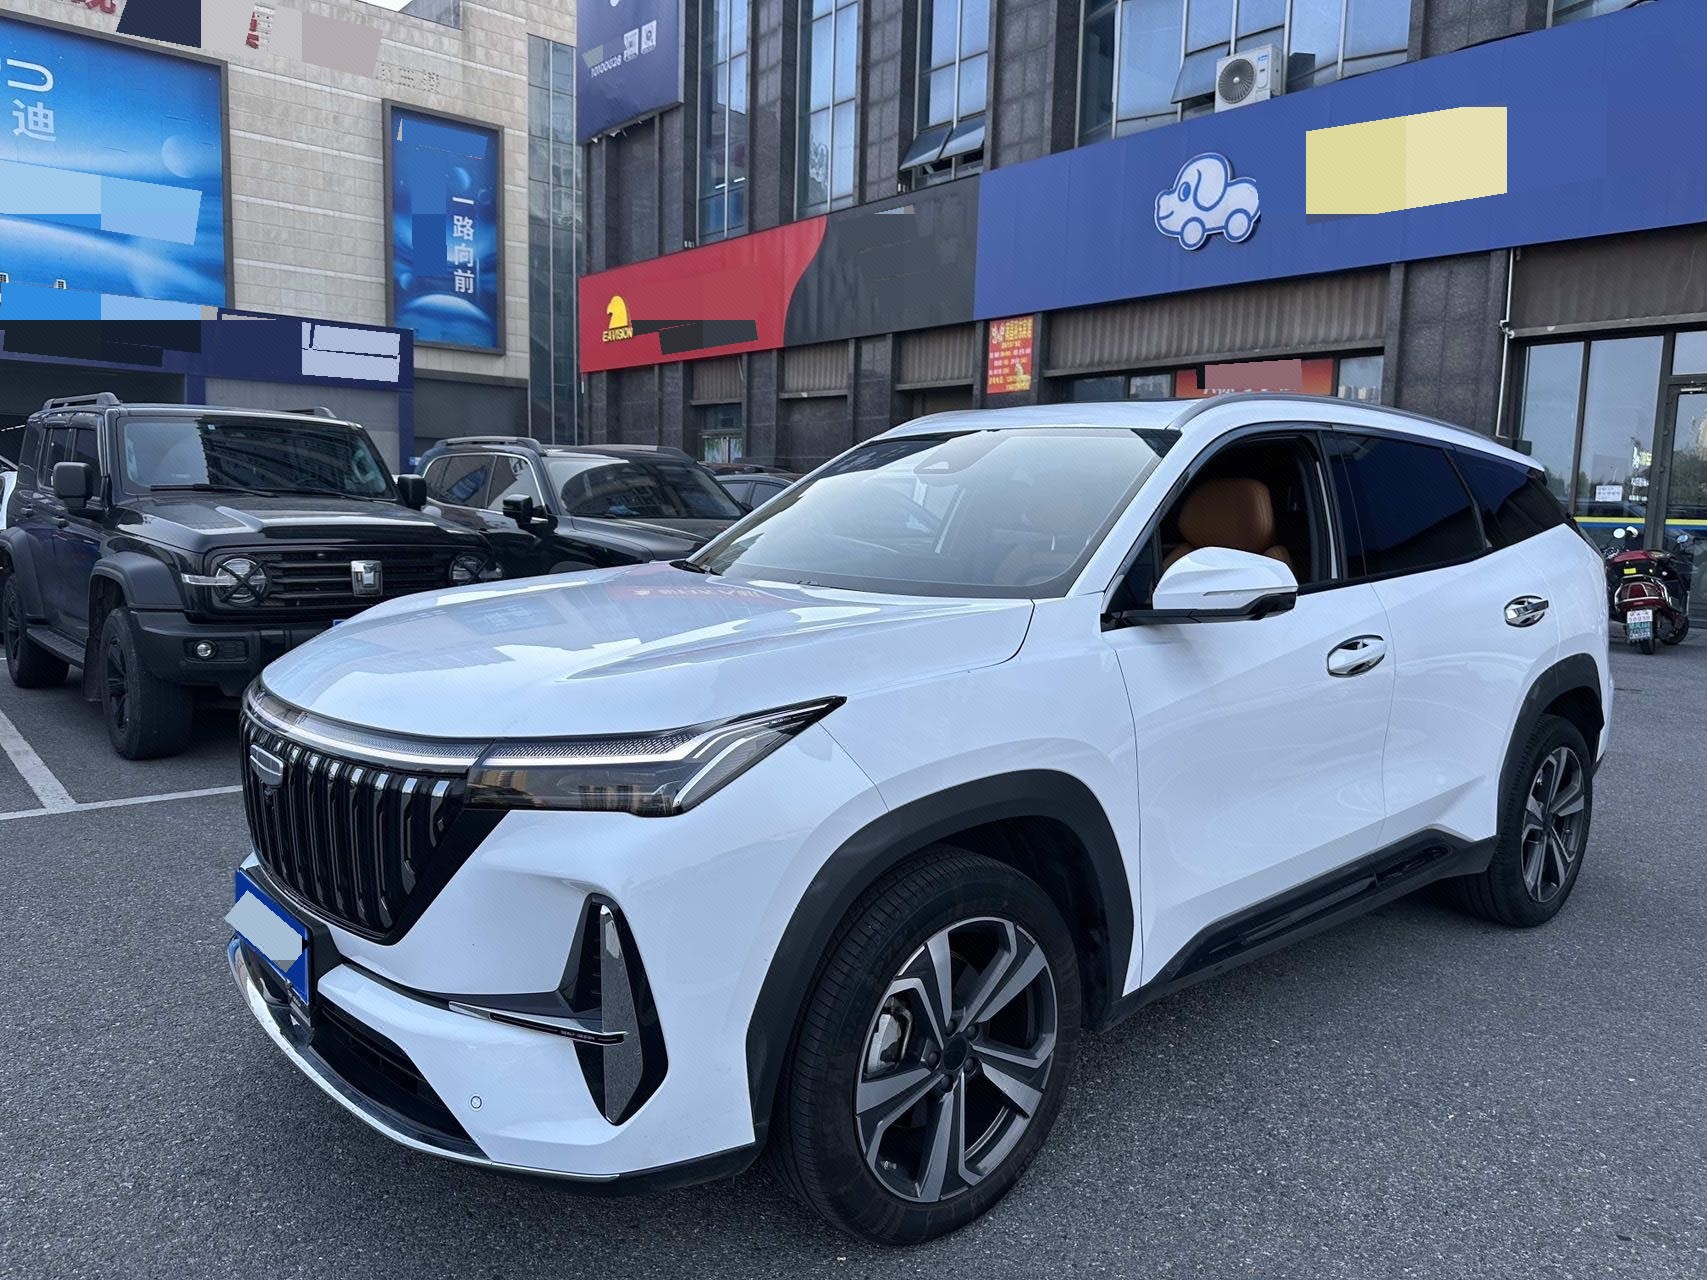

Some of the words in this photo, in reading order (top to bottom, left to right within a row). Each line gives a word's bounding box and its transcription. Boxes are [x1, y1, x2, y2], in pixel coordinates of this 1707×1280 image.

[12, 98, 57, 142] 迪
[452, 196, 475, 294] 一路向前
[602, 326, 634, 342] EAVISION
